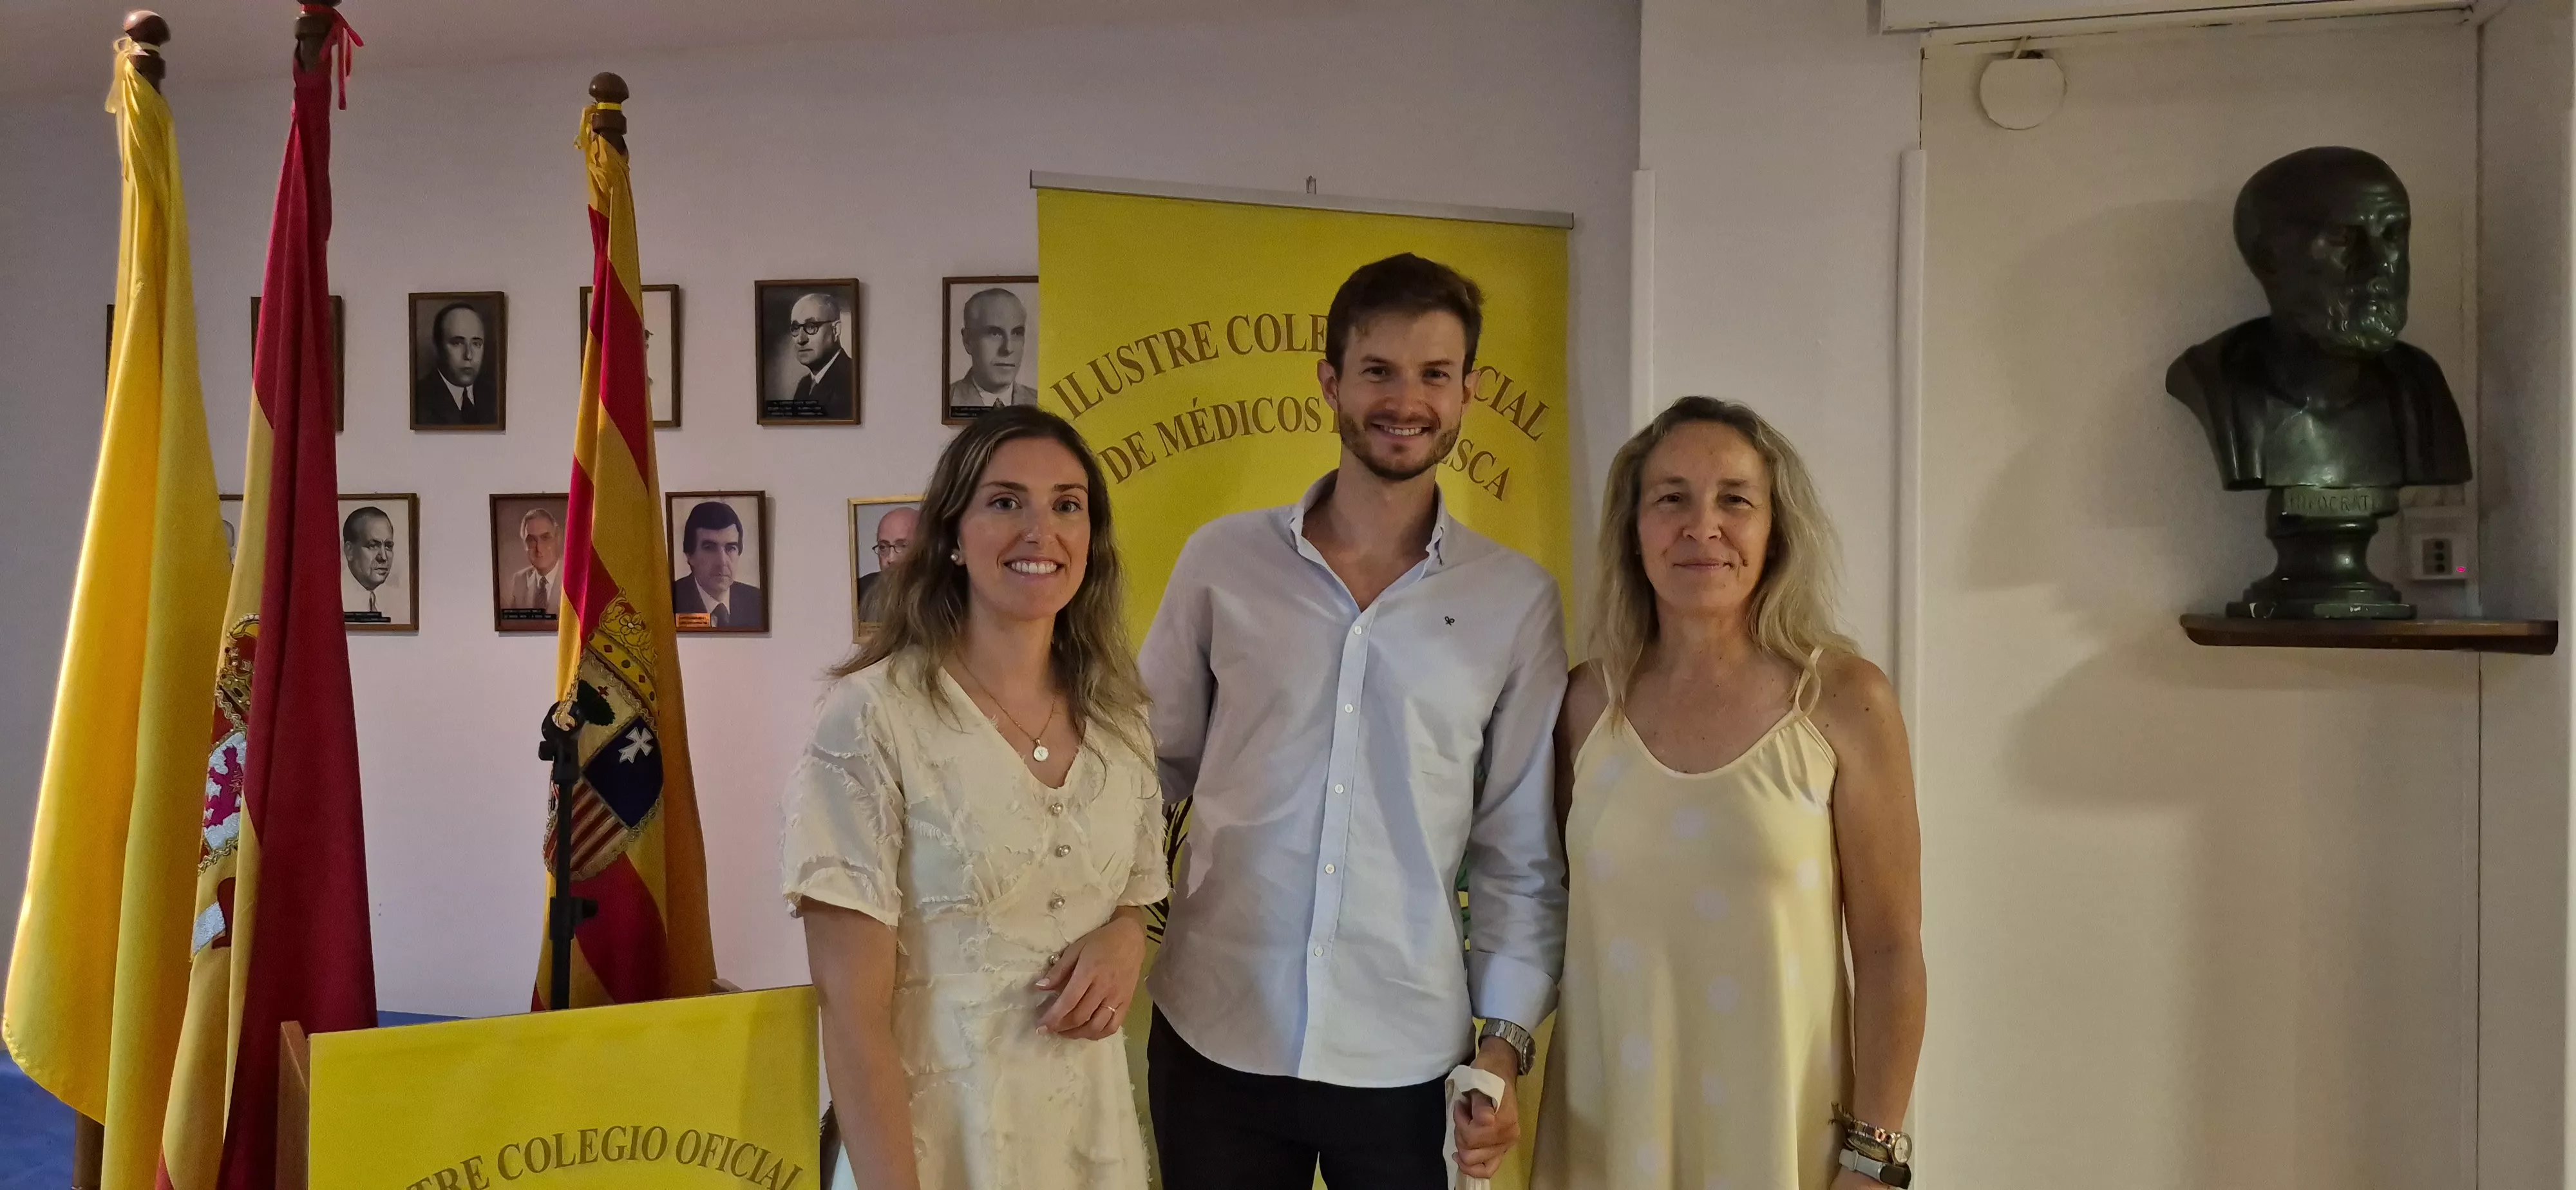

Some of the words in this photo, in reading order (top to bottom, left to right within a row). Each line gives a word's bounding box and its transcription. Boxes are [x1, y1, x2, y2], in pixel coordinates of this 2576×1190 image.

[1050, 320, 1219, 420] ILUSTRE
[1226, 313, 1328, 355] COLE
[1474, 365, 1549, 442] CIAL
[1097, 431, 1157, 484] DE
[1153, 396, 1321, 458] MÉDICOS
[1449, 439, 1510, 501] SCA
[497, 1125, 668, 1180] COLEGIO
